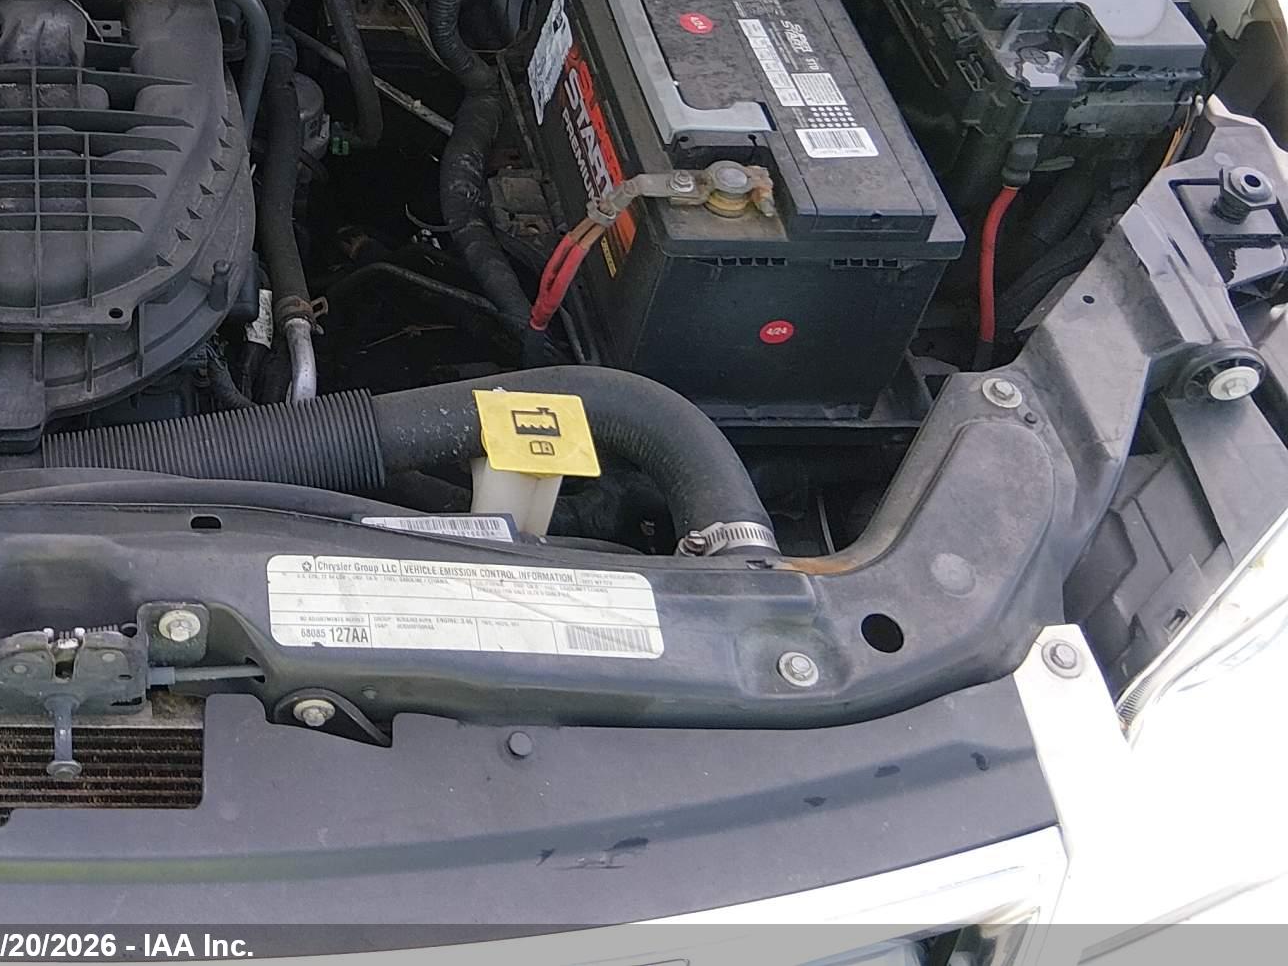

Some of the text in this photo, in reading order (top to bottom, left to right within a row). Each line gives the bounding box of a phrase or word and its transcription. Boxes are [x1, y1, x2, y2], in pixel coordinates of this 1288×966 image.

[317, 561, 398, 575] Chrysler Group LLC
[404, 564, 437, 575] VEHICLE
[439, 566, 478, 577] EMISSION
[479, 569, 516, 579] CONTROL
[518, 571, 574, 583] INFORMATION
[330, 626, 369, 643] 127AA
